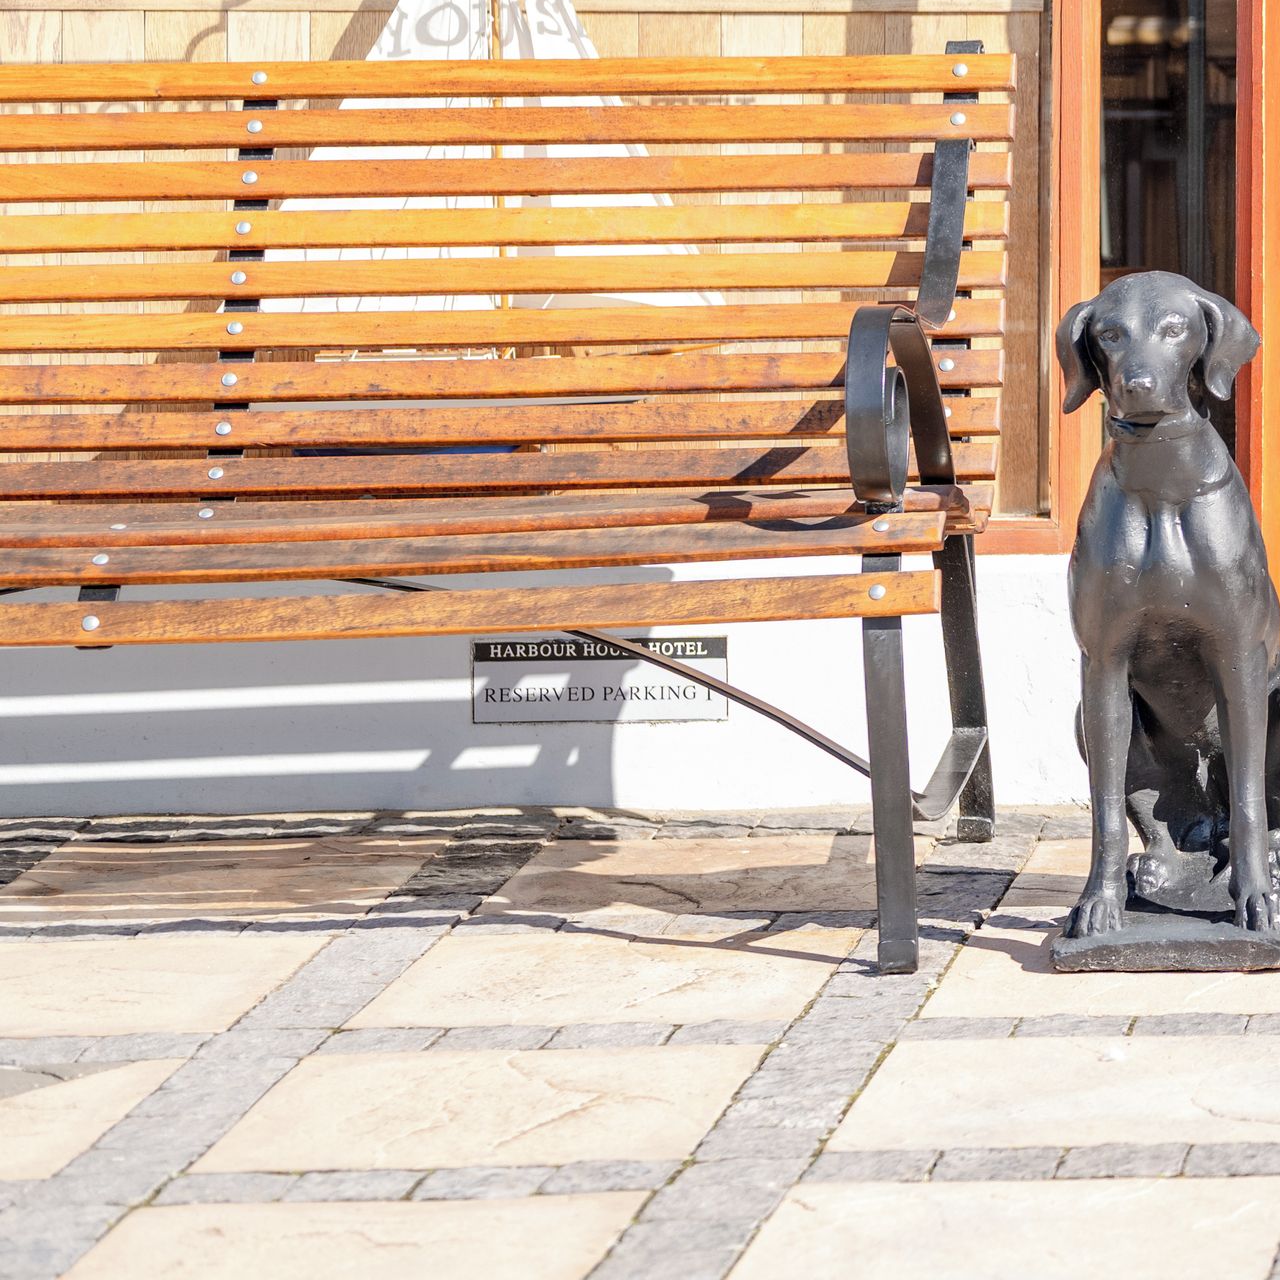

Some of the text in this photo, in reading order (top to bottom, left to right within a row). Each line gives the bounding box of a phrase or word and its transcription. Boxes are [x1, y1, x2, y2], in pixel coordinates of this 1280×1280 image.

[490, 644, 576, 658] HARBOUR
[649, 641, 708, 656] HOTEL
[484, 686, 594, 703] RESERVED
[603, 685, 697, 702] PARKING
